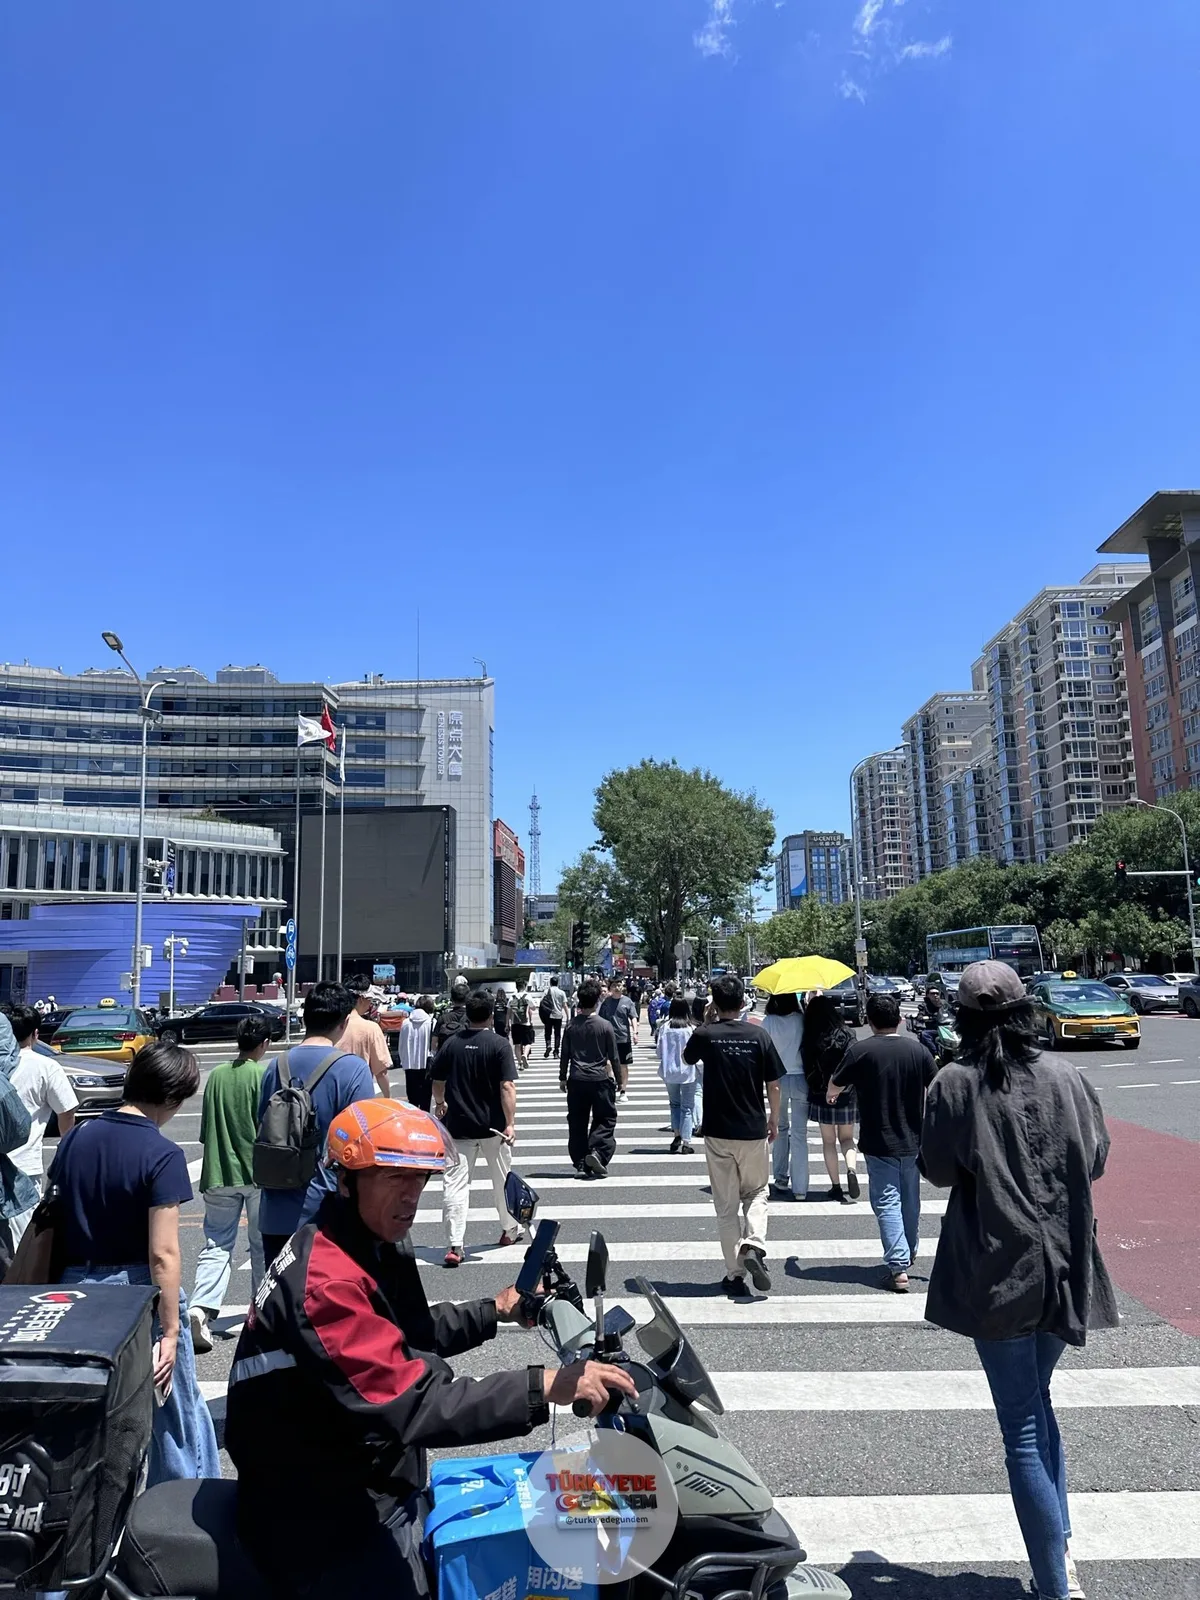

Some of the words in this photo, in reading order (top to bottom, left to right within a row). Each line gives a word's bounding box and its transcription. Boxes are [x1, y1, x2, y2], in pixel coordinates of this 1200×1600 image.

[437, 711, 445, 745] GENESIS
[437, 746, 445, 775] TOWER
[526, 1565, 584, 1591] 用闪送
